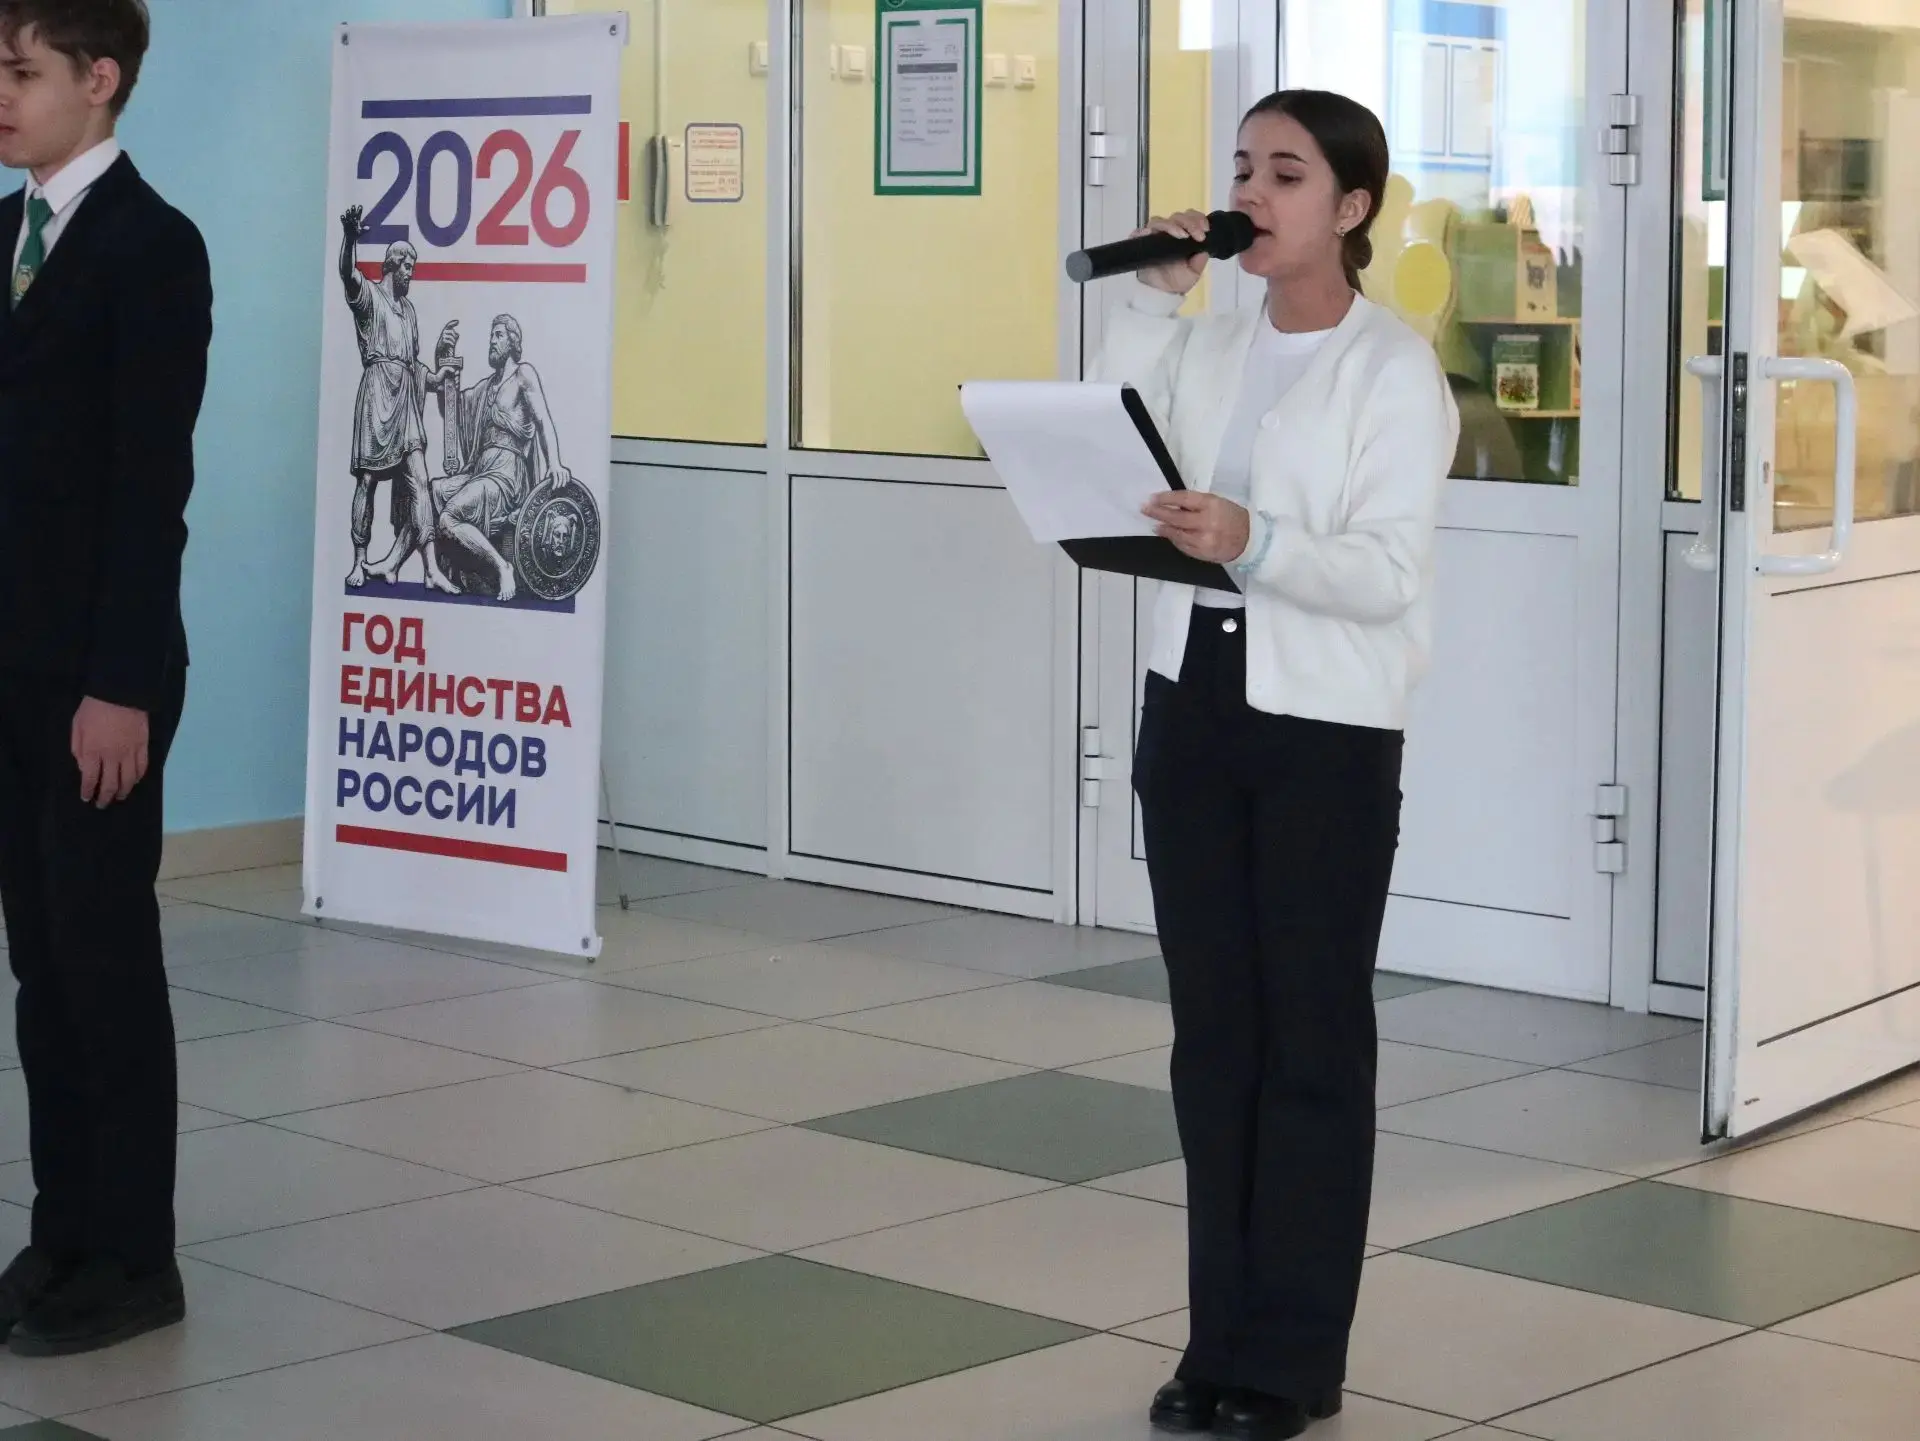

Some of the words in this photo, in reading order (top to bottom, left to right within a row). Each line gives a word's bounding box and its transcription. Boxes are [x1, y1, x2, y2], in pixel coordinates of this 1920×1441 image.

[357, 129, 590, 248] 2026
[342, 612, 425, 665] ГОД
[340, 665, 572, 728] ЕДИНСТВА
[338, 717, 547, 779] НАРОДОВ
[336, 768, 516, 828] РОССИИ
